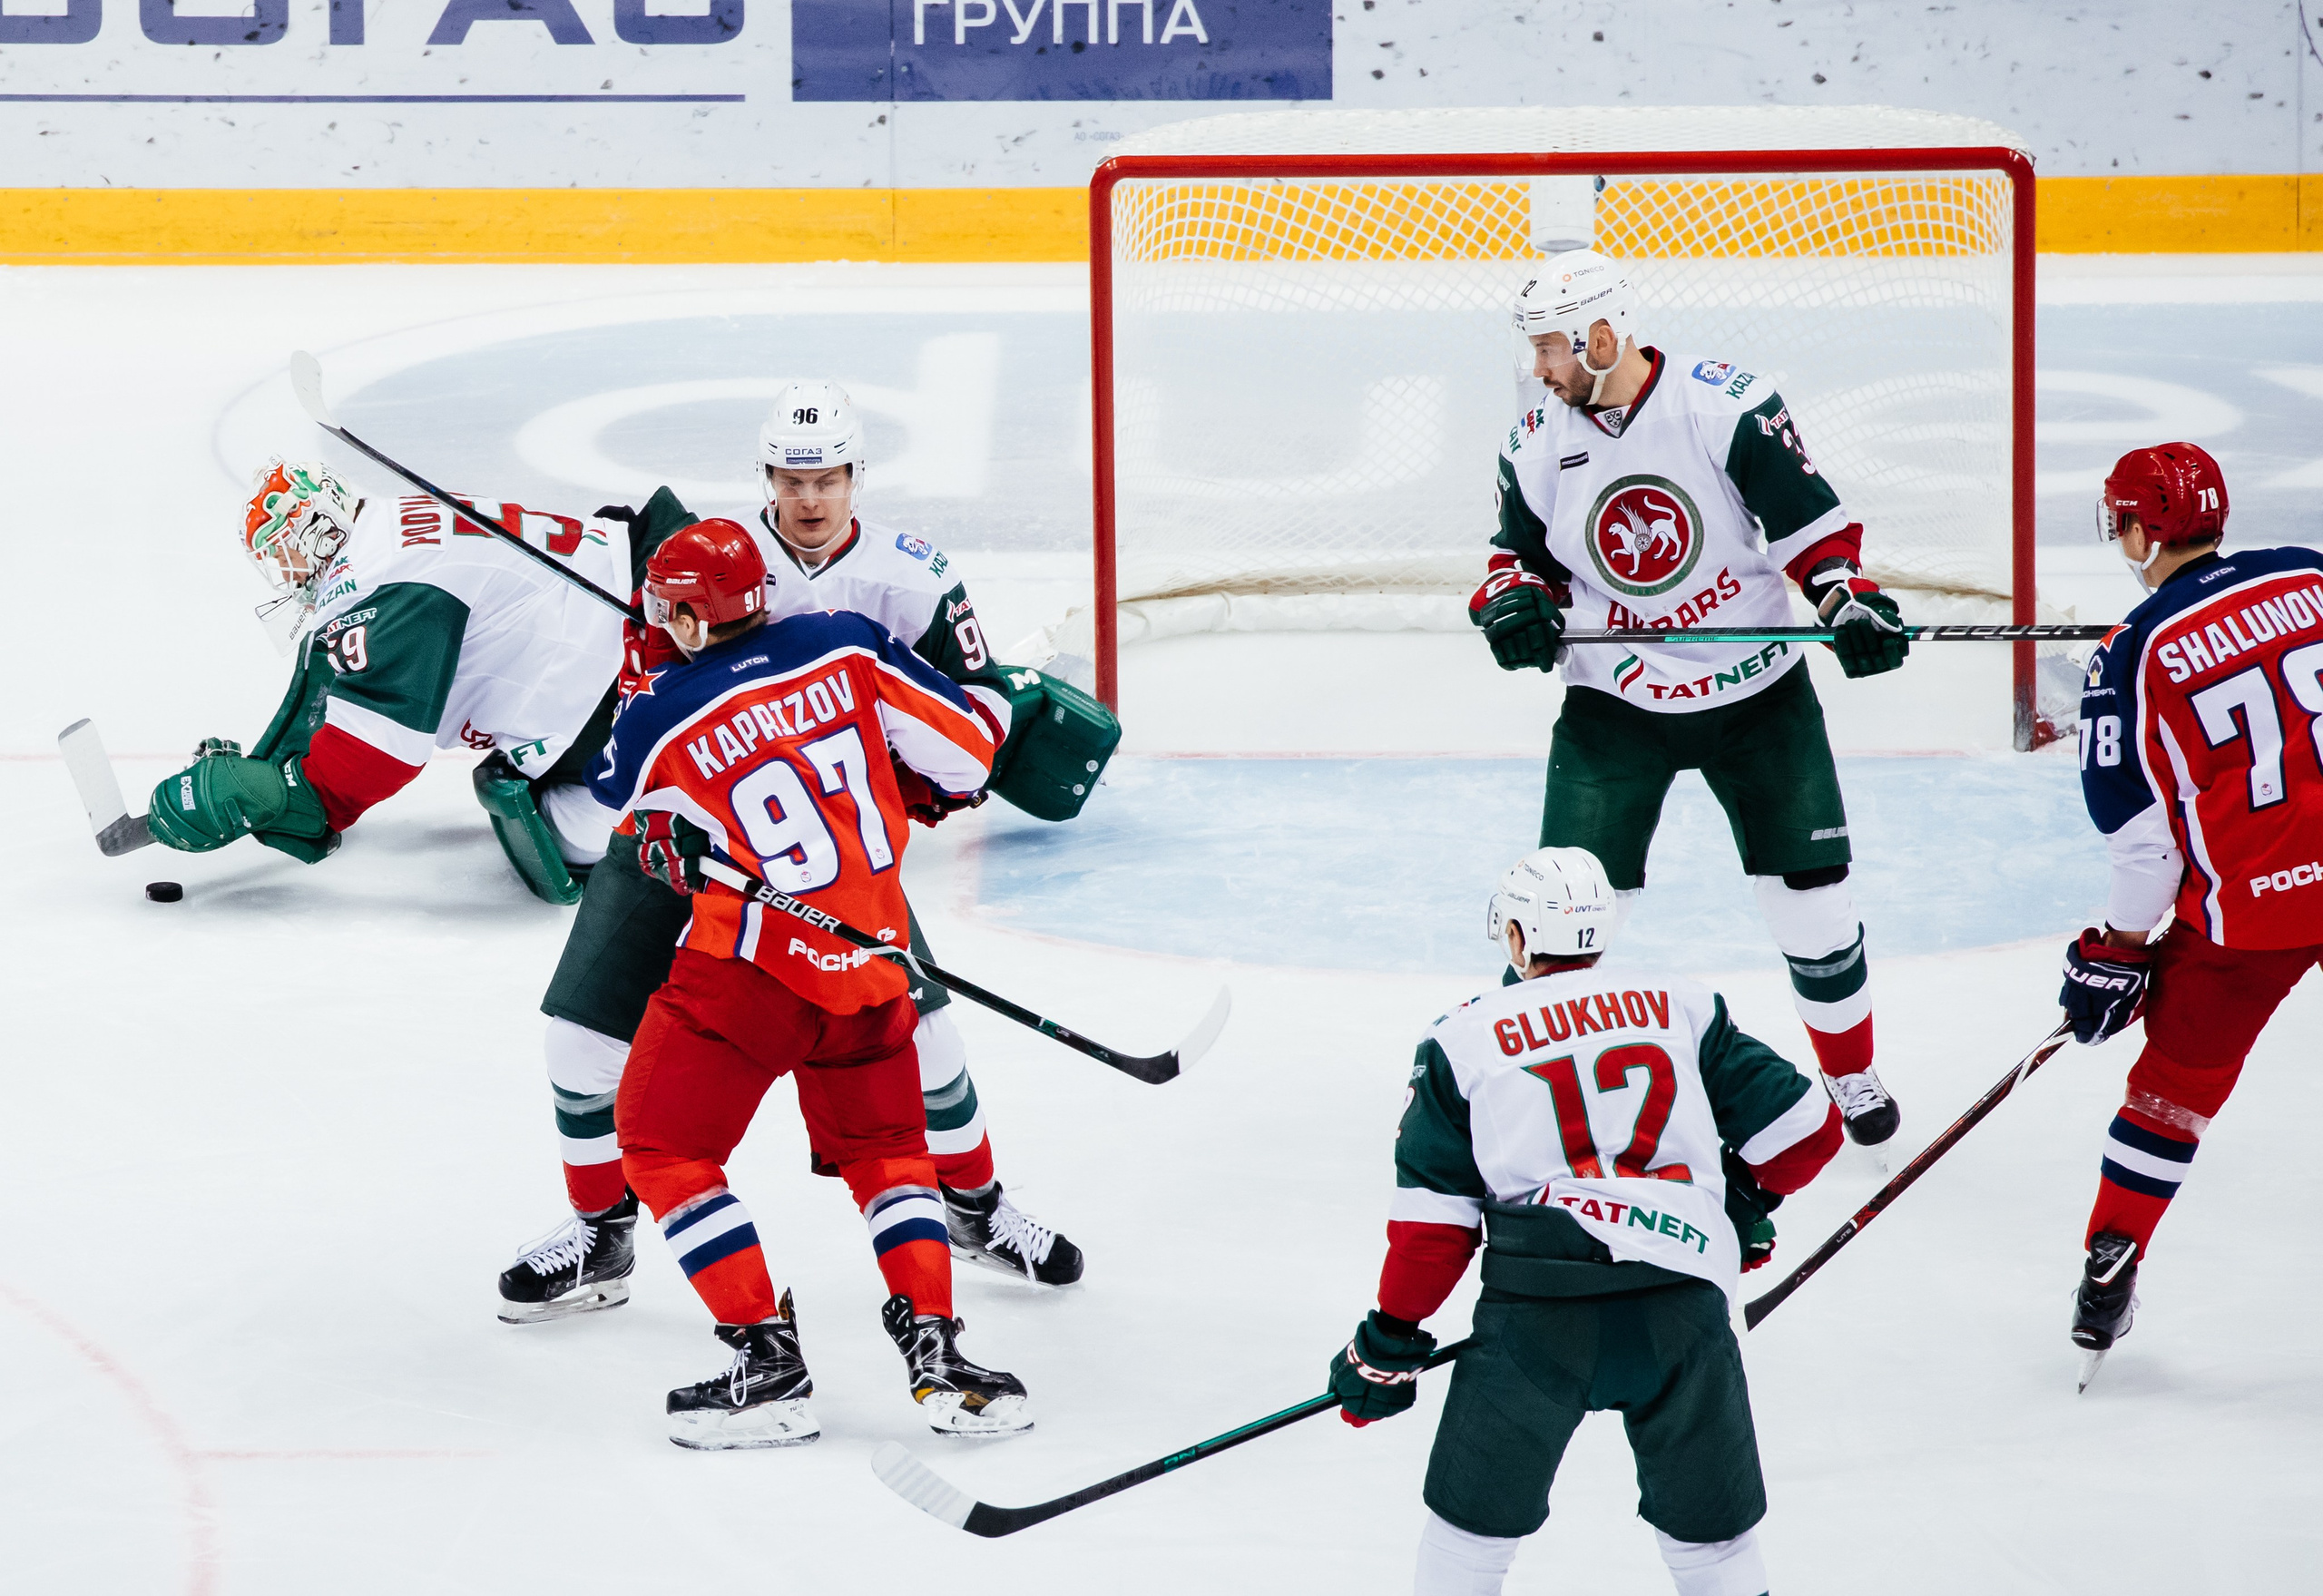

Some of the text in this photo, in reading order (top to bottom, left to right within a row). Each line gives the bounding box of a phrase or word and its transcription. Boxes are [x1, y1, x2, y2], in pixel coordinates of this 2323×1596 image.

[913, 0, 1209, 45] ГРУППА
[792, 407, 818, 426] 96
[2198, 487, 2220, 513] 78
[2199, 565, 2237, 584] LUTCH
[744, 585, 762, 612] 97
[328, 608, 377, 634] ATNEFT
[731, 655, 769, 673] LUTCH
[686, 669, 856, 780] KAPRIZOV
[2078, 715, 2122, 771] 78
[729, 721, 896, 896] 97
[754, 885, 842, 934] BAUER
[1574, 906, 1593, 914] UVT
[1577, 927, 1596, 949] 12
[1493, 990, 1670, 1057] GLUKHOV
[1519, 1042, 1694, 1187] 12
[1556, 1196, 1710, 1255] TATNEFT
